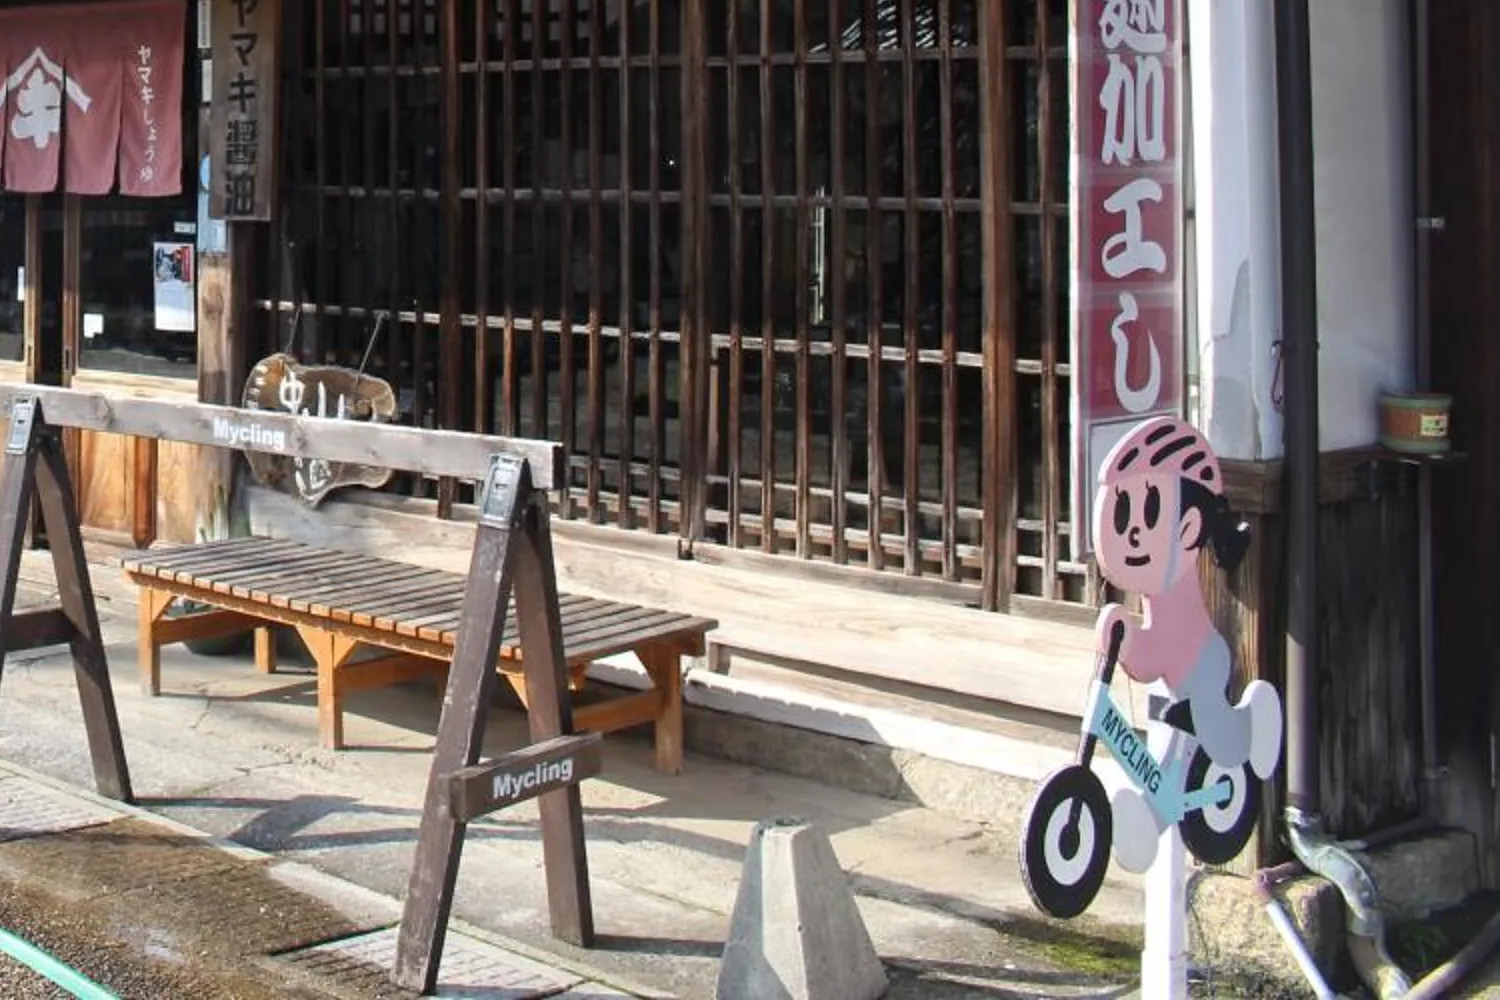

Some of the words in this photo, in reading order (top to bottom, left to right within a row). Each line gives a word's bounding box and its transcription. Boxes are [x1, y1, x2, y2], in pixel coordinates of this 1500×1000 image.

[213, 416, 285, 451] Mycling
[1101, 708, 1162, 795] MYCLING
[493, 758, 573, 800] Mycling
